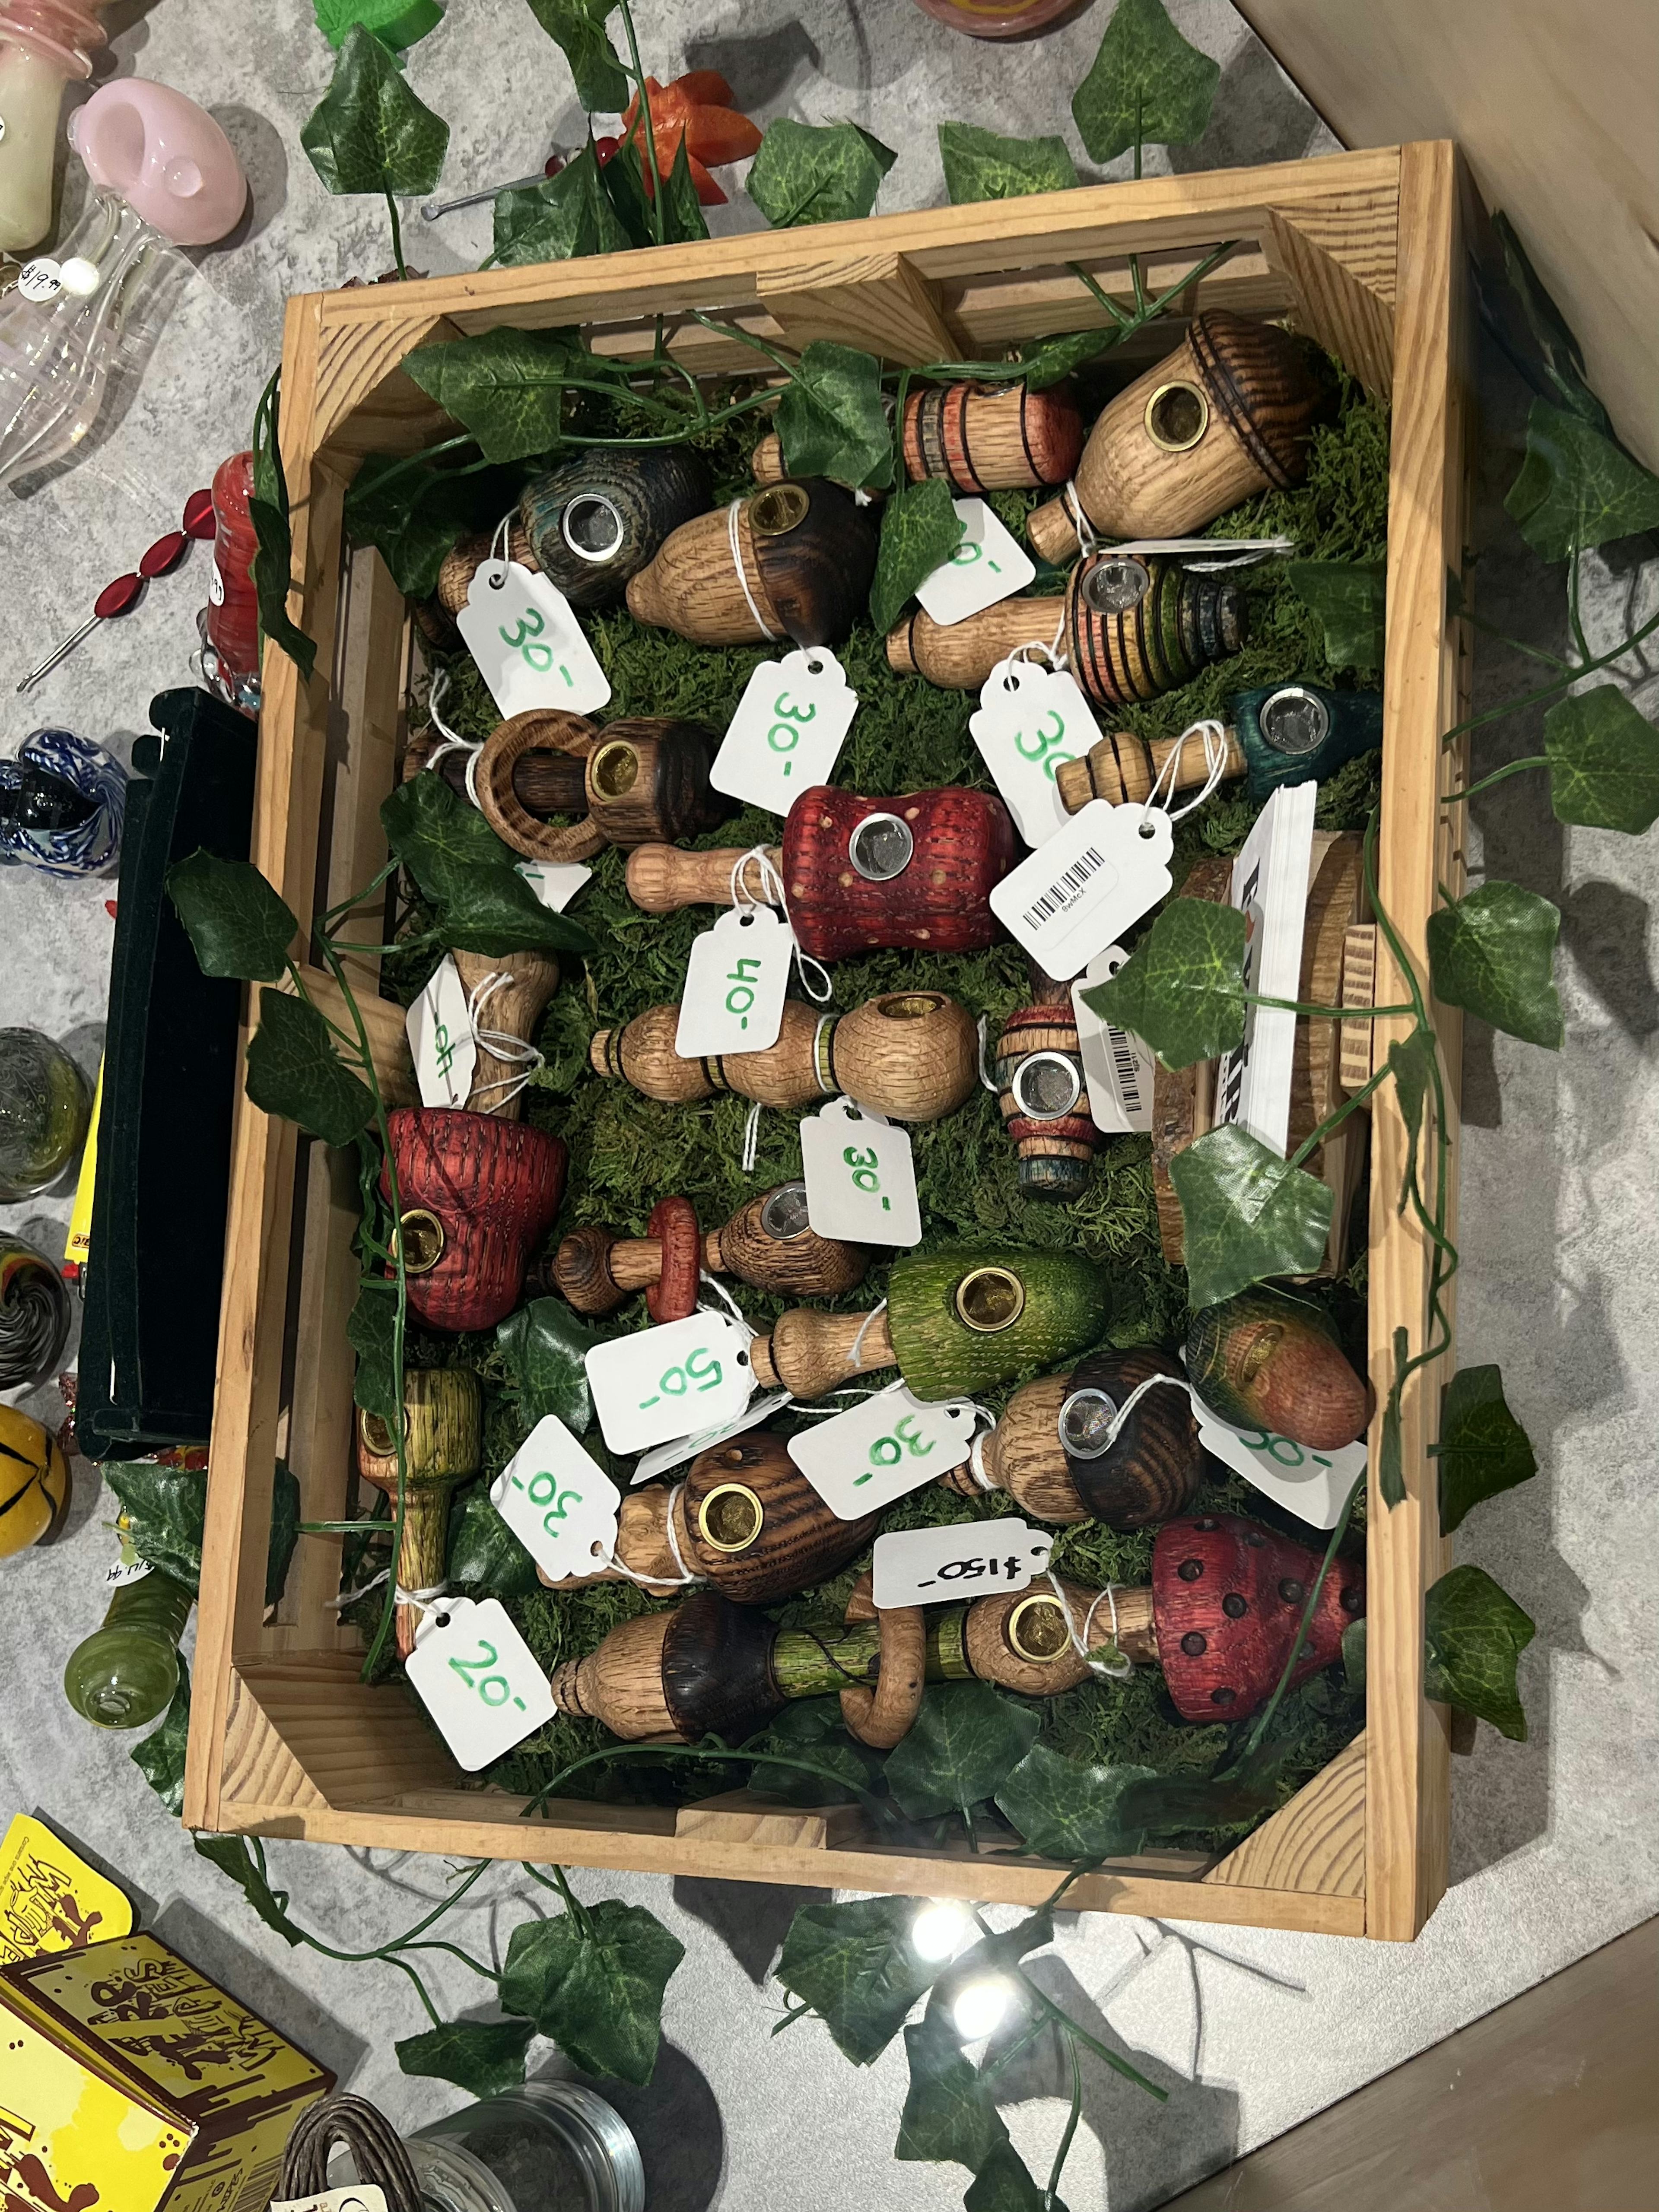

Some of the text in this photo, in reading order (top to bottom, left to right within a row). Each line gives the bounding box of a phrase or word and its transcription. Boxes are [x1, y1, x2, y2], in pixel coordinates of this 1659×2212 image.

[21, 264, 61, 290] $19.99
[948, 520, 1001, 573] 0-
[499, 607, 573, 687] 30-
[768, 692, 816, 776] 30-
[726, 958, 761, 1029] 40-
[843, 1146, 891, 1211] 30-
[639, 1348, 722, 1409] 50-
[853, 1415, 936, 1486] 30-
[512, 1472, 582, 1537] 30-
[918, 1556, 1021, 1587] $150-
[448, 1640, 527, 1711] 20-
